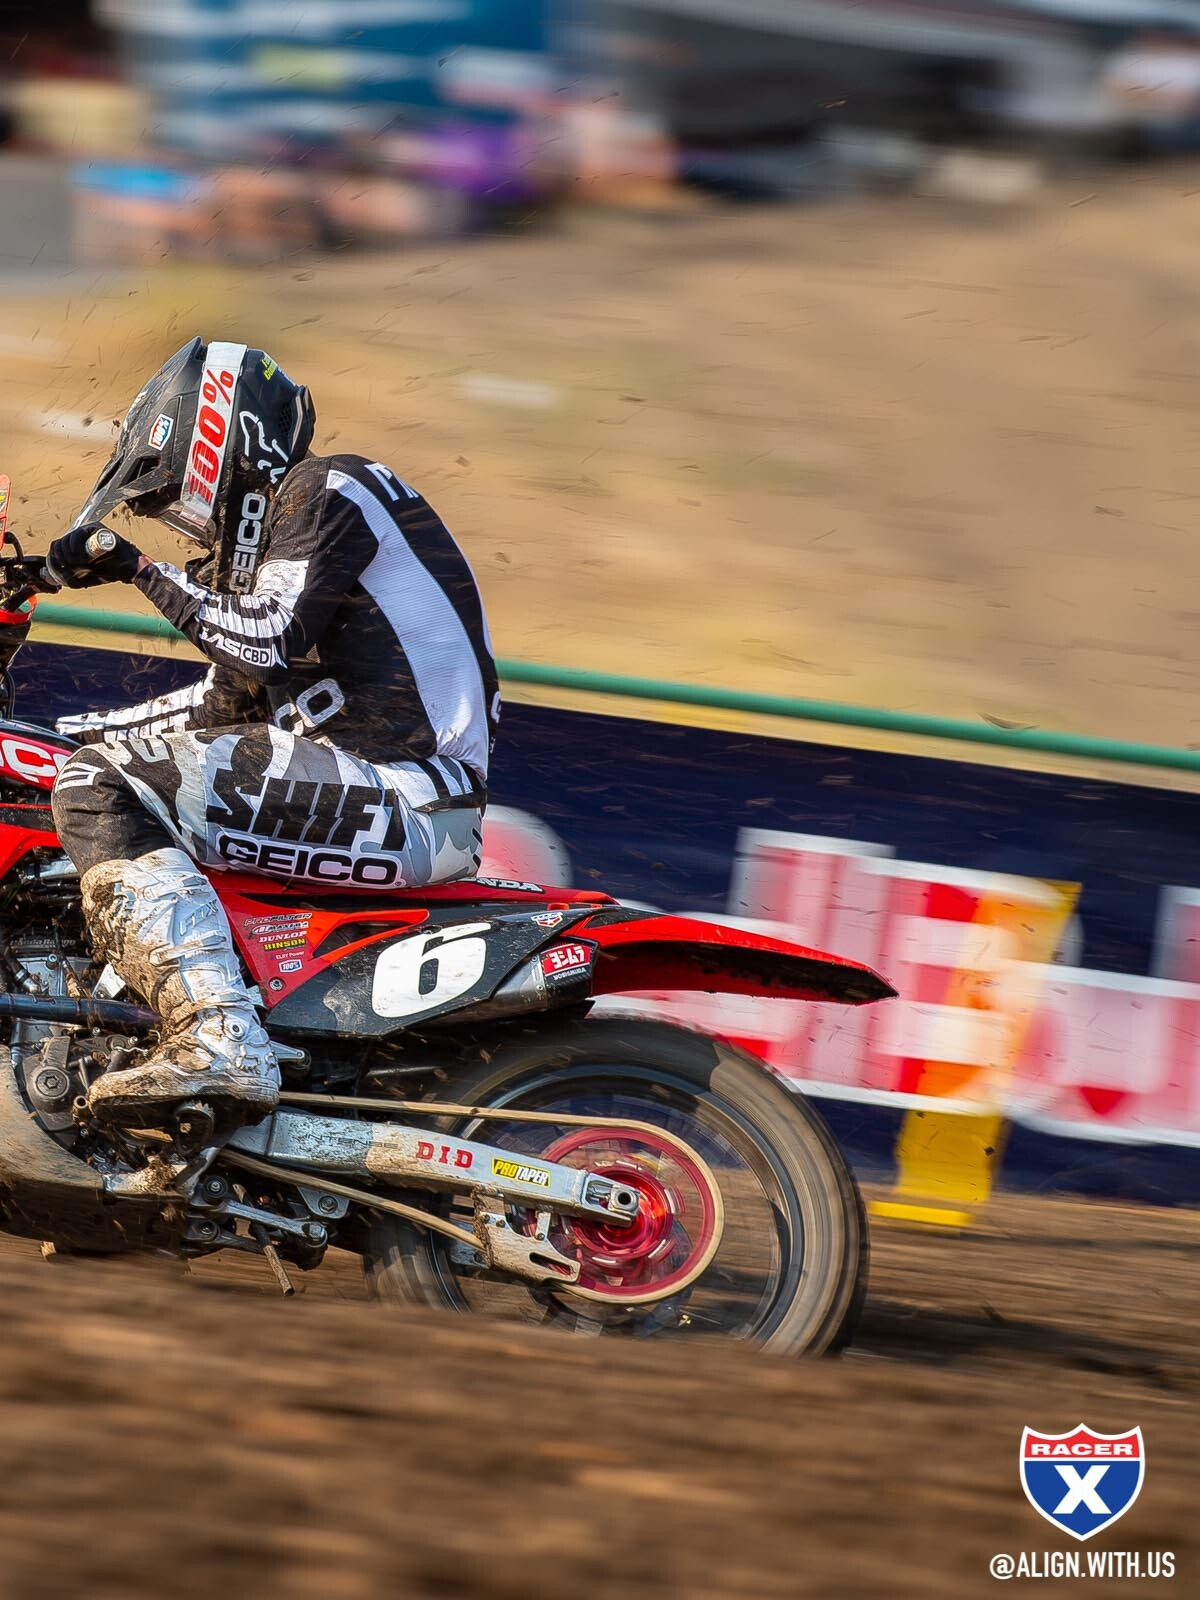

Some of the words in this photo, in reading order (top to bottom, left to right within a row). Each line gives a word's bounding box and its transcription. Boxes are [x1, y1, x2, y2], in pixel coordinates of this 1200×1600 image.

[151, 416, 171, 448] 100%
[188, 369, 235, 506] 100%
[228, 492, 267, 594] GEICO
[242, 649, 270, 665] CBD
[219, 834, 399, 885] GEICO
[259, 930, 308, 943] DUNLOP
[263, 938, 306, 951] HINSON
[282, 961, 300, 971] 100%
[371, 922, 492, 1019] 6
